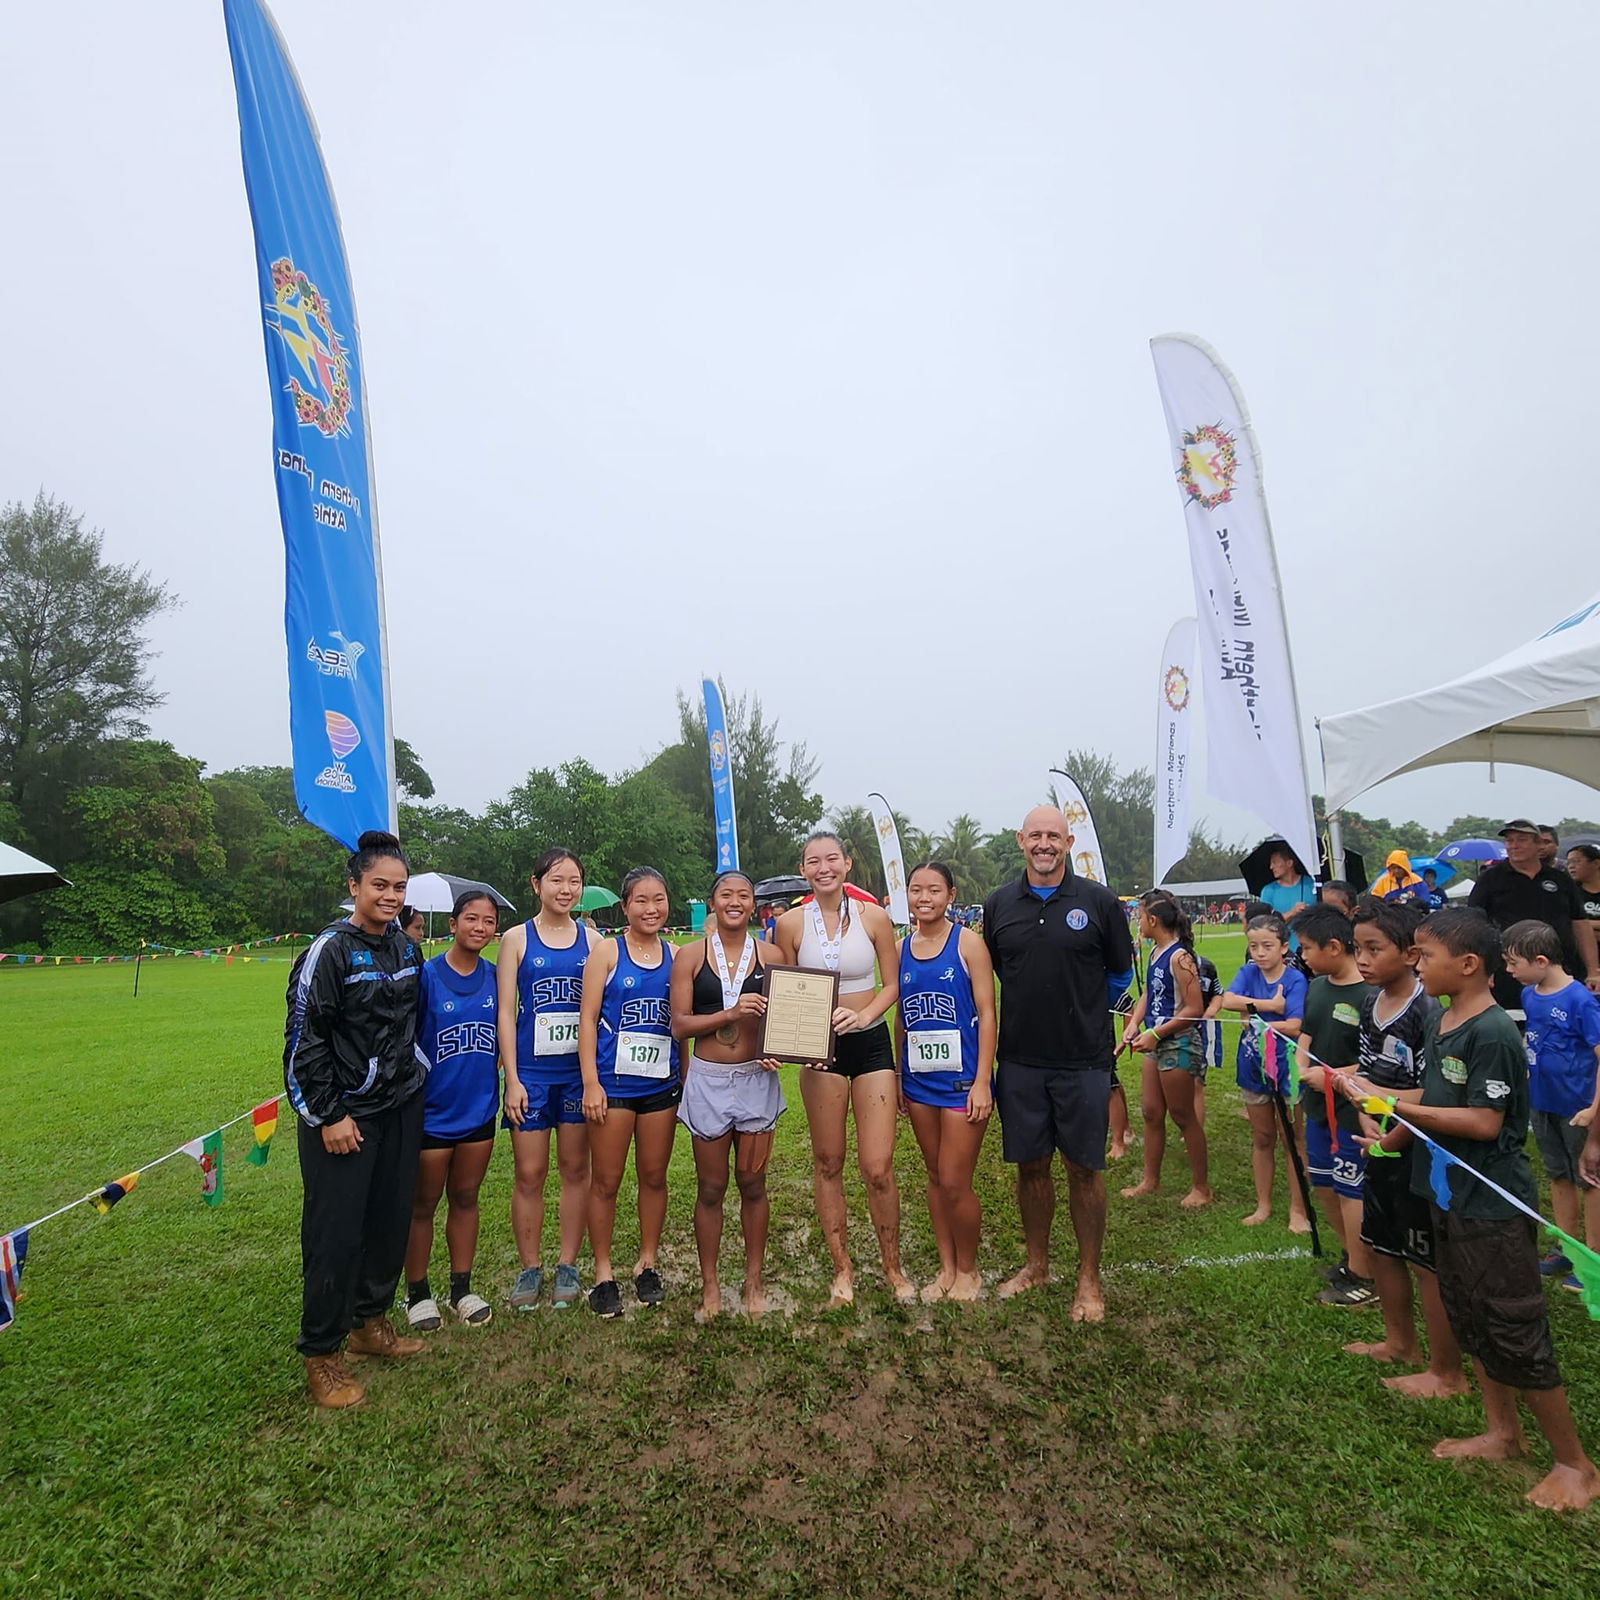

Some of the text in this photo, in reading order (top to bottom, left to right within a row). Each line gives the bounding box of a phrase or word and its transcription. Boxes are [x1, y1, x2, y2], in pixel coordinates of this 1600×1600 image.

[1167, 721, 1176, 829] Northern Marianas
[532, 976, 583, 1012] SIS
[903, 991, 957, 1028] SIS
[619, 997, 672, 1030] SIS
[436, 1021, 496, 1064] SIS
[629, 1045, 660, 1064] 1377
[918, 1042, 950, 1060] 1379
[1333, 1157, 1358, 1179] 23
[1408, 1227, 1430, 1256] 15
